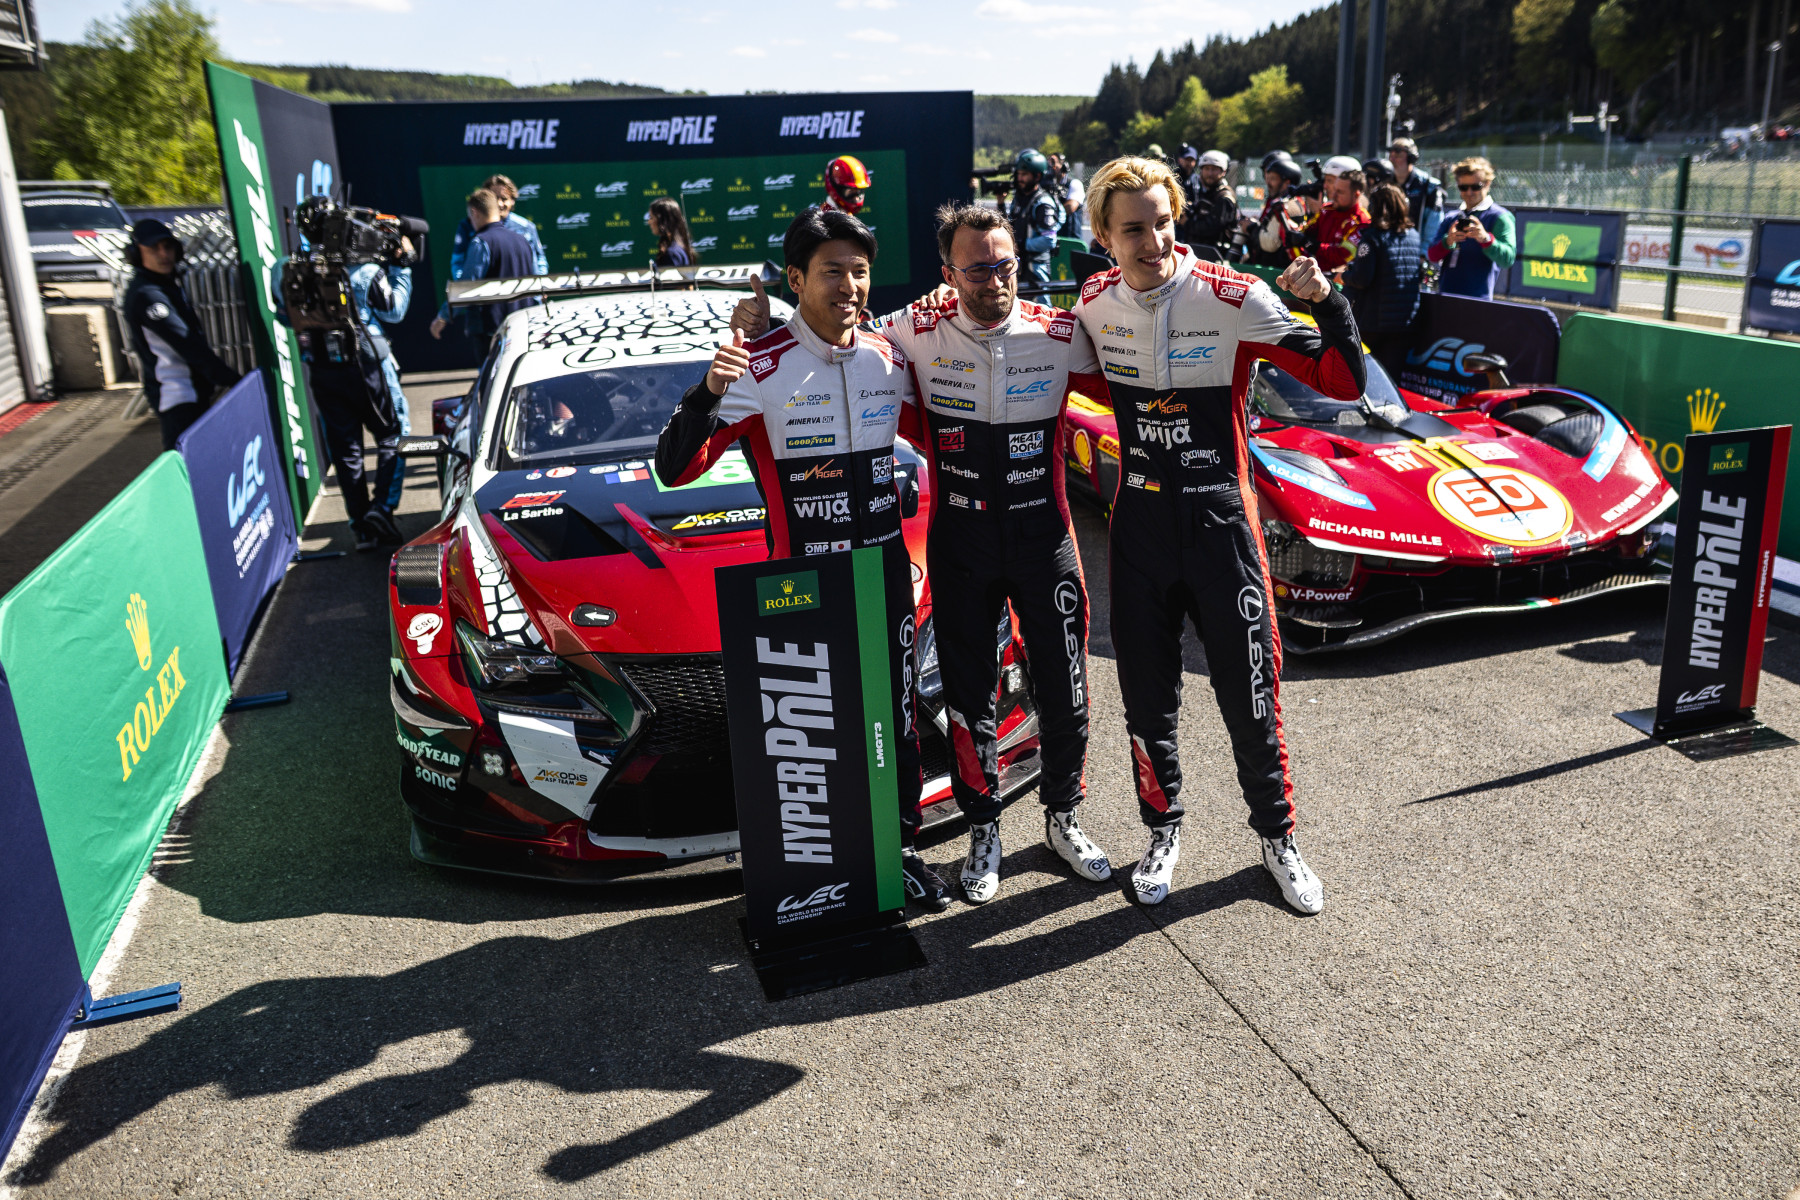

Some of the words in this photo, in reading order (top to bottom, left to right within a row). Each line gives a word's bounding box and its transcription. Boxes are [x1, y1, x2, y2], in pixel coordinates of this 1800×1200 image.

[1530, 261, 1589, 283] ROLEX
[458, 267, 686, 298] MINERVA
[1084, 283, 1100, 296] OMP
[1220, 286, 1245, 298] OMP
[915, 316, 935, 327] OMP
[1049, 325, 1072, 336] OMP
[1181, 330, 1219, 338] LEXUS
[1168, 347, 1216, 359] WEC
[752, 358, 773, 373] OMP
[1019, 365, 1055, 373] LEXUS
[930, 377, 962, 388] MINERVA
[1006, 380, 1052, 395] WEC
[932, 396, 974, 408] GOODYEAR
[861, 404, 896, 419] WEC
[786, 416, 821, 427] MINERVA
[938, 425, 965, 434] PROJET
[788, 436, 834, 447] GOODYEAR
[1010, 441, 1043, 453] DORIA
[1381, 453, 1423, 472] HY
[1713, 459, 1743, 470] ROLEX
[941, 461, 950, 471] La
[951, 465, 979, 479] Sarthe
[1006, 467, 1046, 484] glinche
[1267, 463, 1308, 485] ADLER
[228, 434, 265, 528] WEC
[1128, 475, 1145, 486] OMP
[1197, 483, 1230, 493] GEHRSITZ
[949, 495, 969, 506] OMP
[1451, 479, 1535, 512] 50
[1008, 502, 1028, 511] Arnold
[1028, 497, 1047, 507] ROBIN
[504, 511, 519, 522] La
[521, 507, 564, 519] Sarthe
[697, 519, 721, 527] ASP
[723, 514, 759, 523] TEAM
[833, 515, 852, 523] 0.0%
[1308, 517, 1385, 540] RICHARD
[1390, 532, 1442, 546] MILLE
[805, 544, 829, 553] OMP
[1757, 549, 1770, 608] HYPERCAR
[1291, 588, 1351, 600] V-Power
[765, 593, 813, 610] ROLEX
[1062, 617, 1083, 708] LEXUS
[1248, 624, 1268, 720] LEXUS
[1677, 684, 1726, 704] WEC
[116, 646, 187, 782] ROLEX
[874, 722, 885, 768] LMGT3
[777, 882, 850, 912] WEC
[789, 909, 809, 918] WORLD
[811, 902, 846, 913] ENDURANCE
[777, 911, 823, 925] CHAMPIONSHIP
